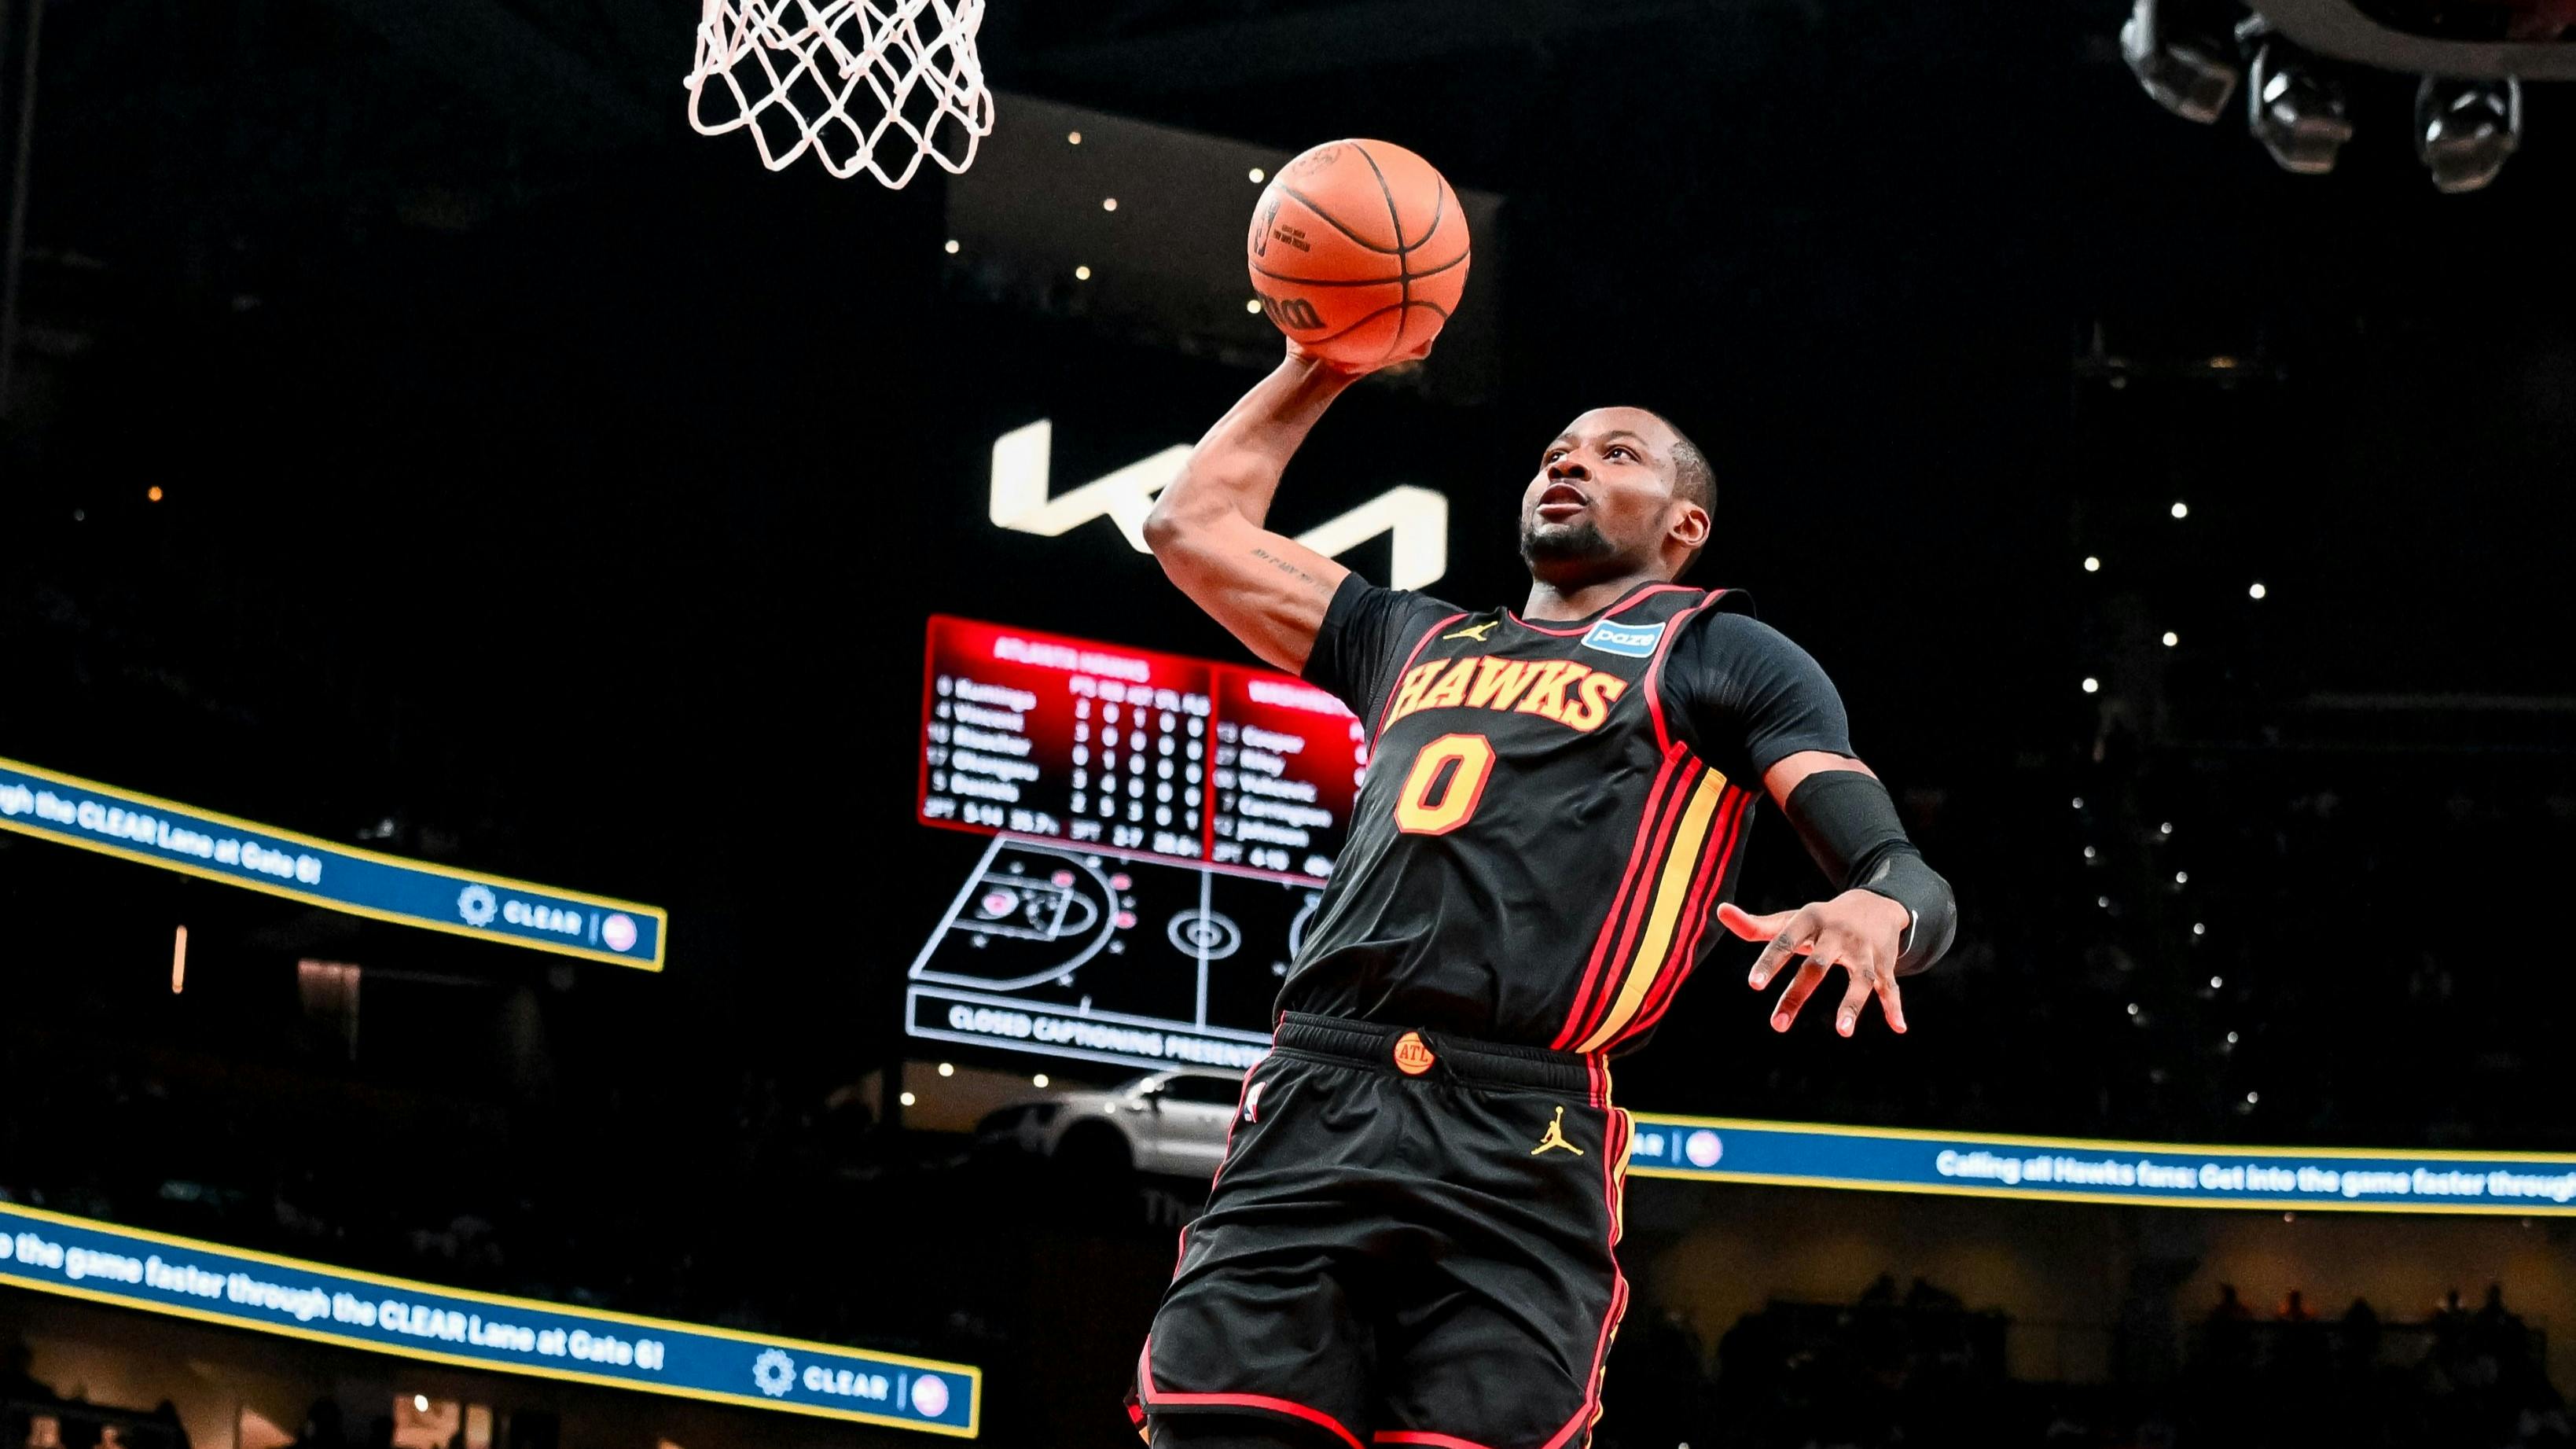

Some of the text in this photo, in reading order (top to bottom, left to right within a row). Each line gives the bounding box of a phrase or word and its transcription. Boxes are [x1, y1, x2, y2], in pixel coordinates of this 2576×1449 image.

[1593, 628, 1656, 646] paze
[1381, 655, 1628, 733] HAWKS
[1394, 733, 1496, 836] 0
[78, 800, 156, 844] CLEAR
[503, 899, 582, 936] CLEAR
[948, 1004, 1032, 1038] CLOSED
[1032, 1016, 1164, 1057] CAPTIONING
[1399, 1043, 1428, 1063] ATL
[1936, 1149, 2021, 1184] Calling
[2053, 1157, 2136, 1186] Hawks
[16, 1233, 64, 1270] the
[65, 1247, 143, 1284] game
[145, 1255, 226, 1299] faster
[227, 1272, 331, 1322] through
[333, 1292, 377, 1326] the
[378, 1300, 467, 1343] CLEAR
[468, 1315, 536, 1352] Lane
[537, 1327, 567, 1357] at
[568, 1329, 634, 1366] Gate
[803, 1366, 889, 1401] CLEAR
